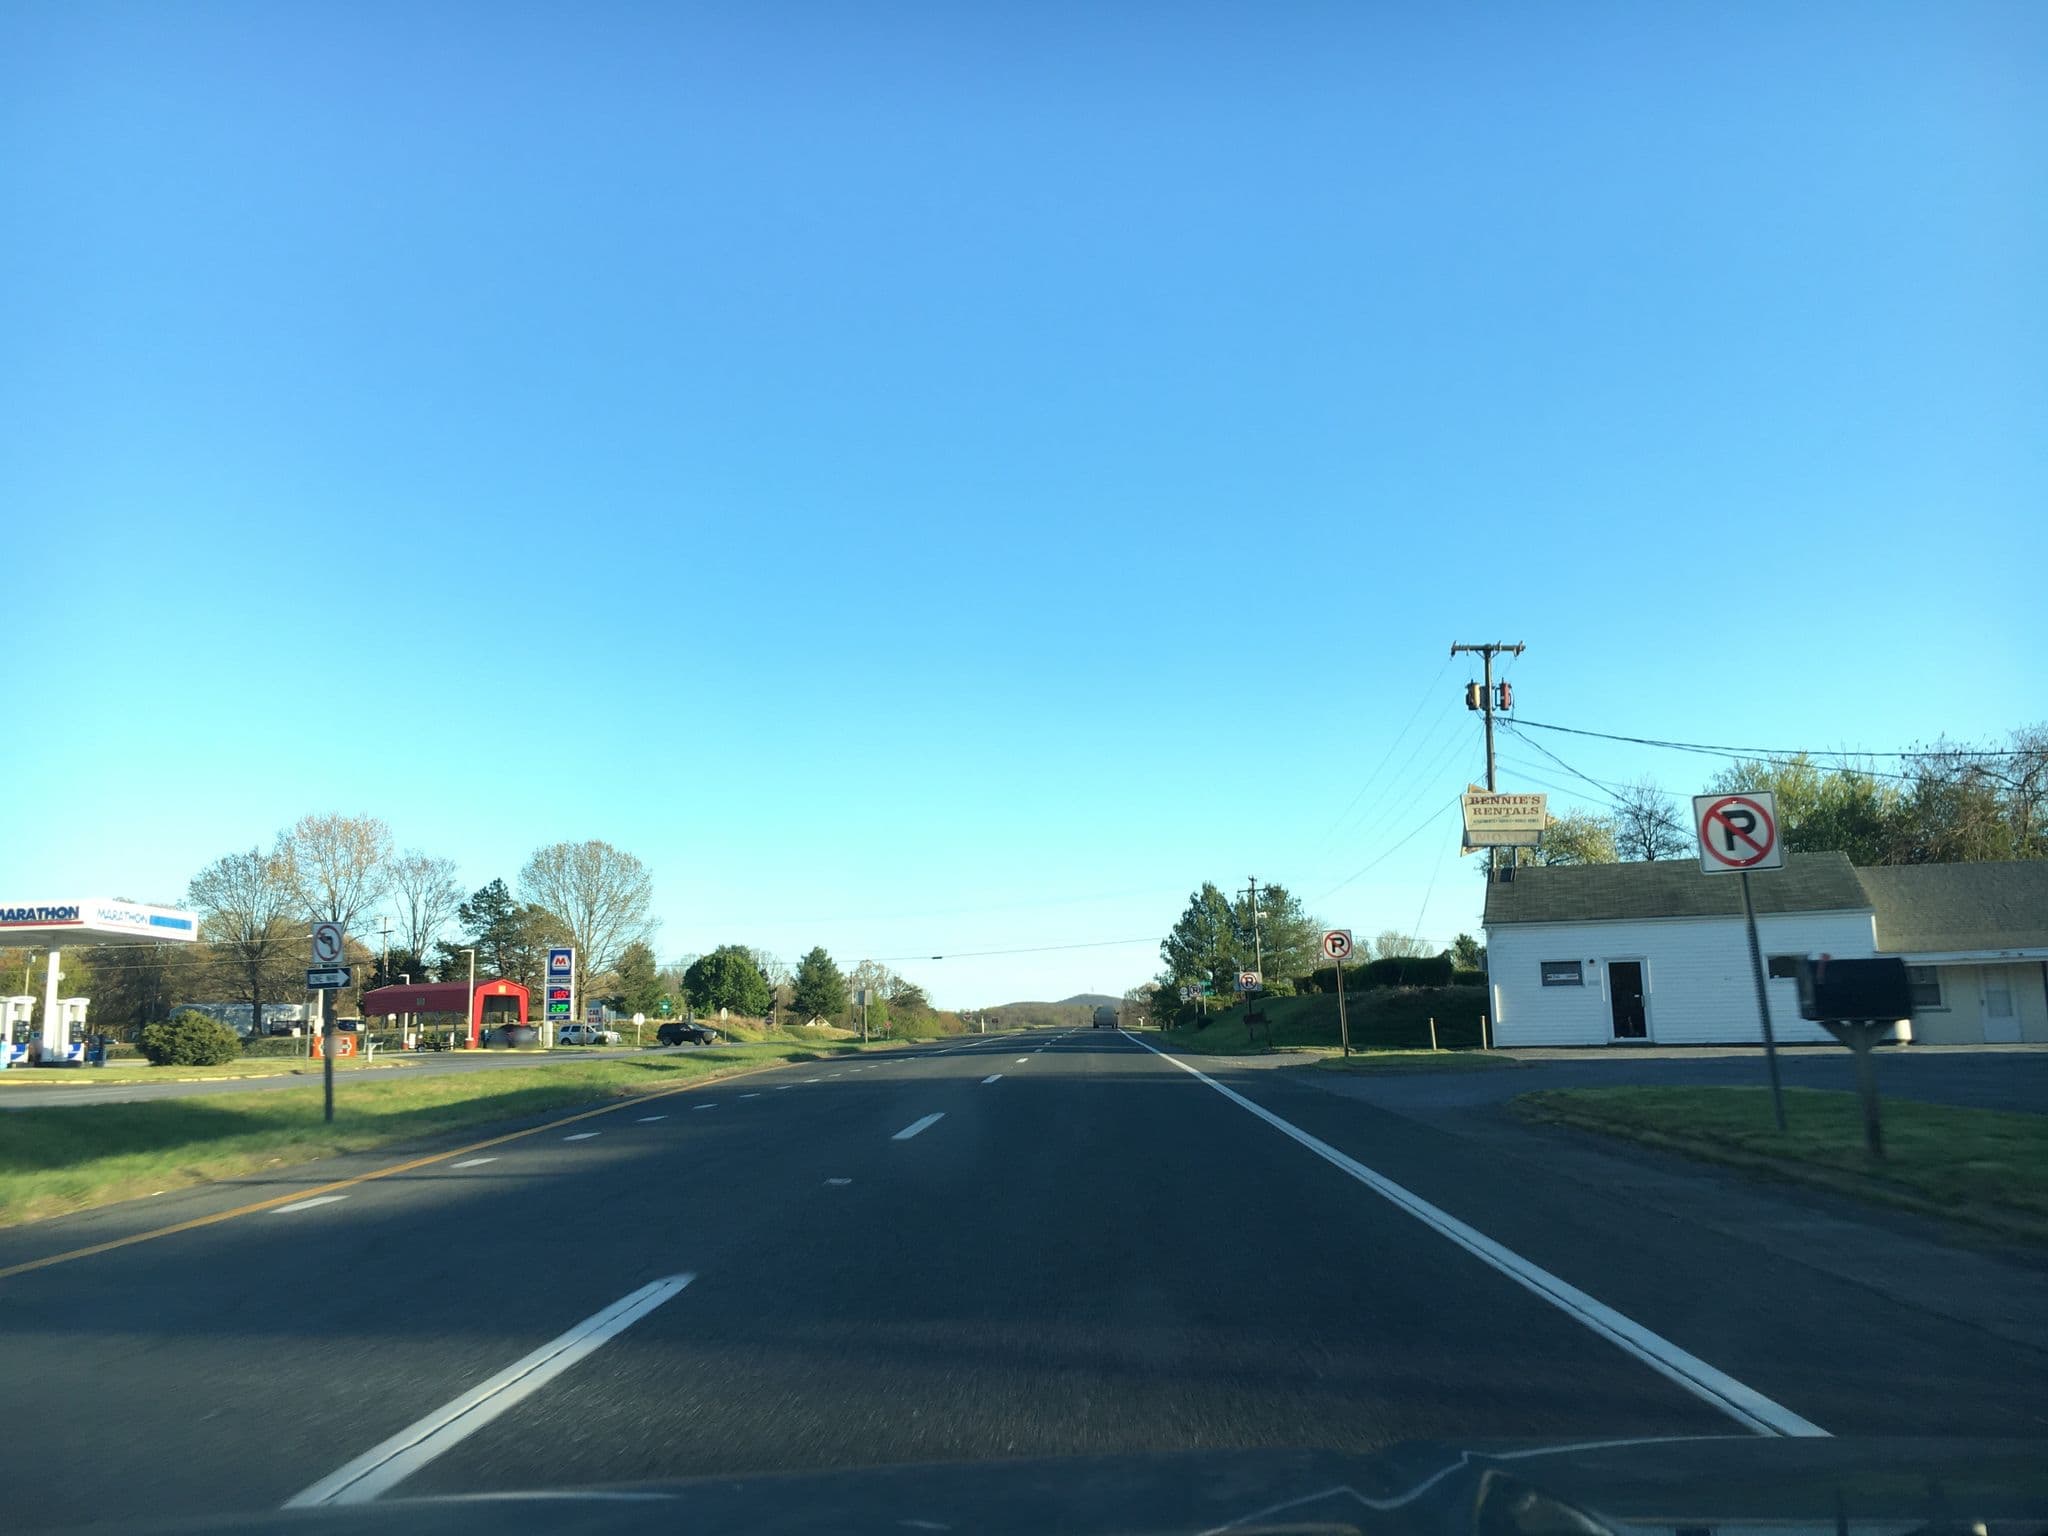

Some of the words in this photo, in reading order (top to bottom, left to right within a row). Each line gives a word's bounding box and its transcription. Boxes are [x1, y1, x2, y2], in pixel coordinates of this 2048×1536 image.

[1470, 796, 1540, 805] BENNIE'S
[1472, 806, 1539, 815] RENTALS
[1720, 809, 1757, 852] P
[96, 908, 148, 924] MARATHON
[1331, 937, 1345, 953] P
